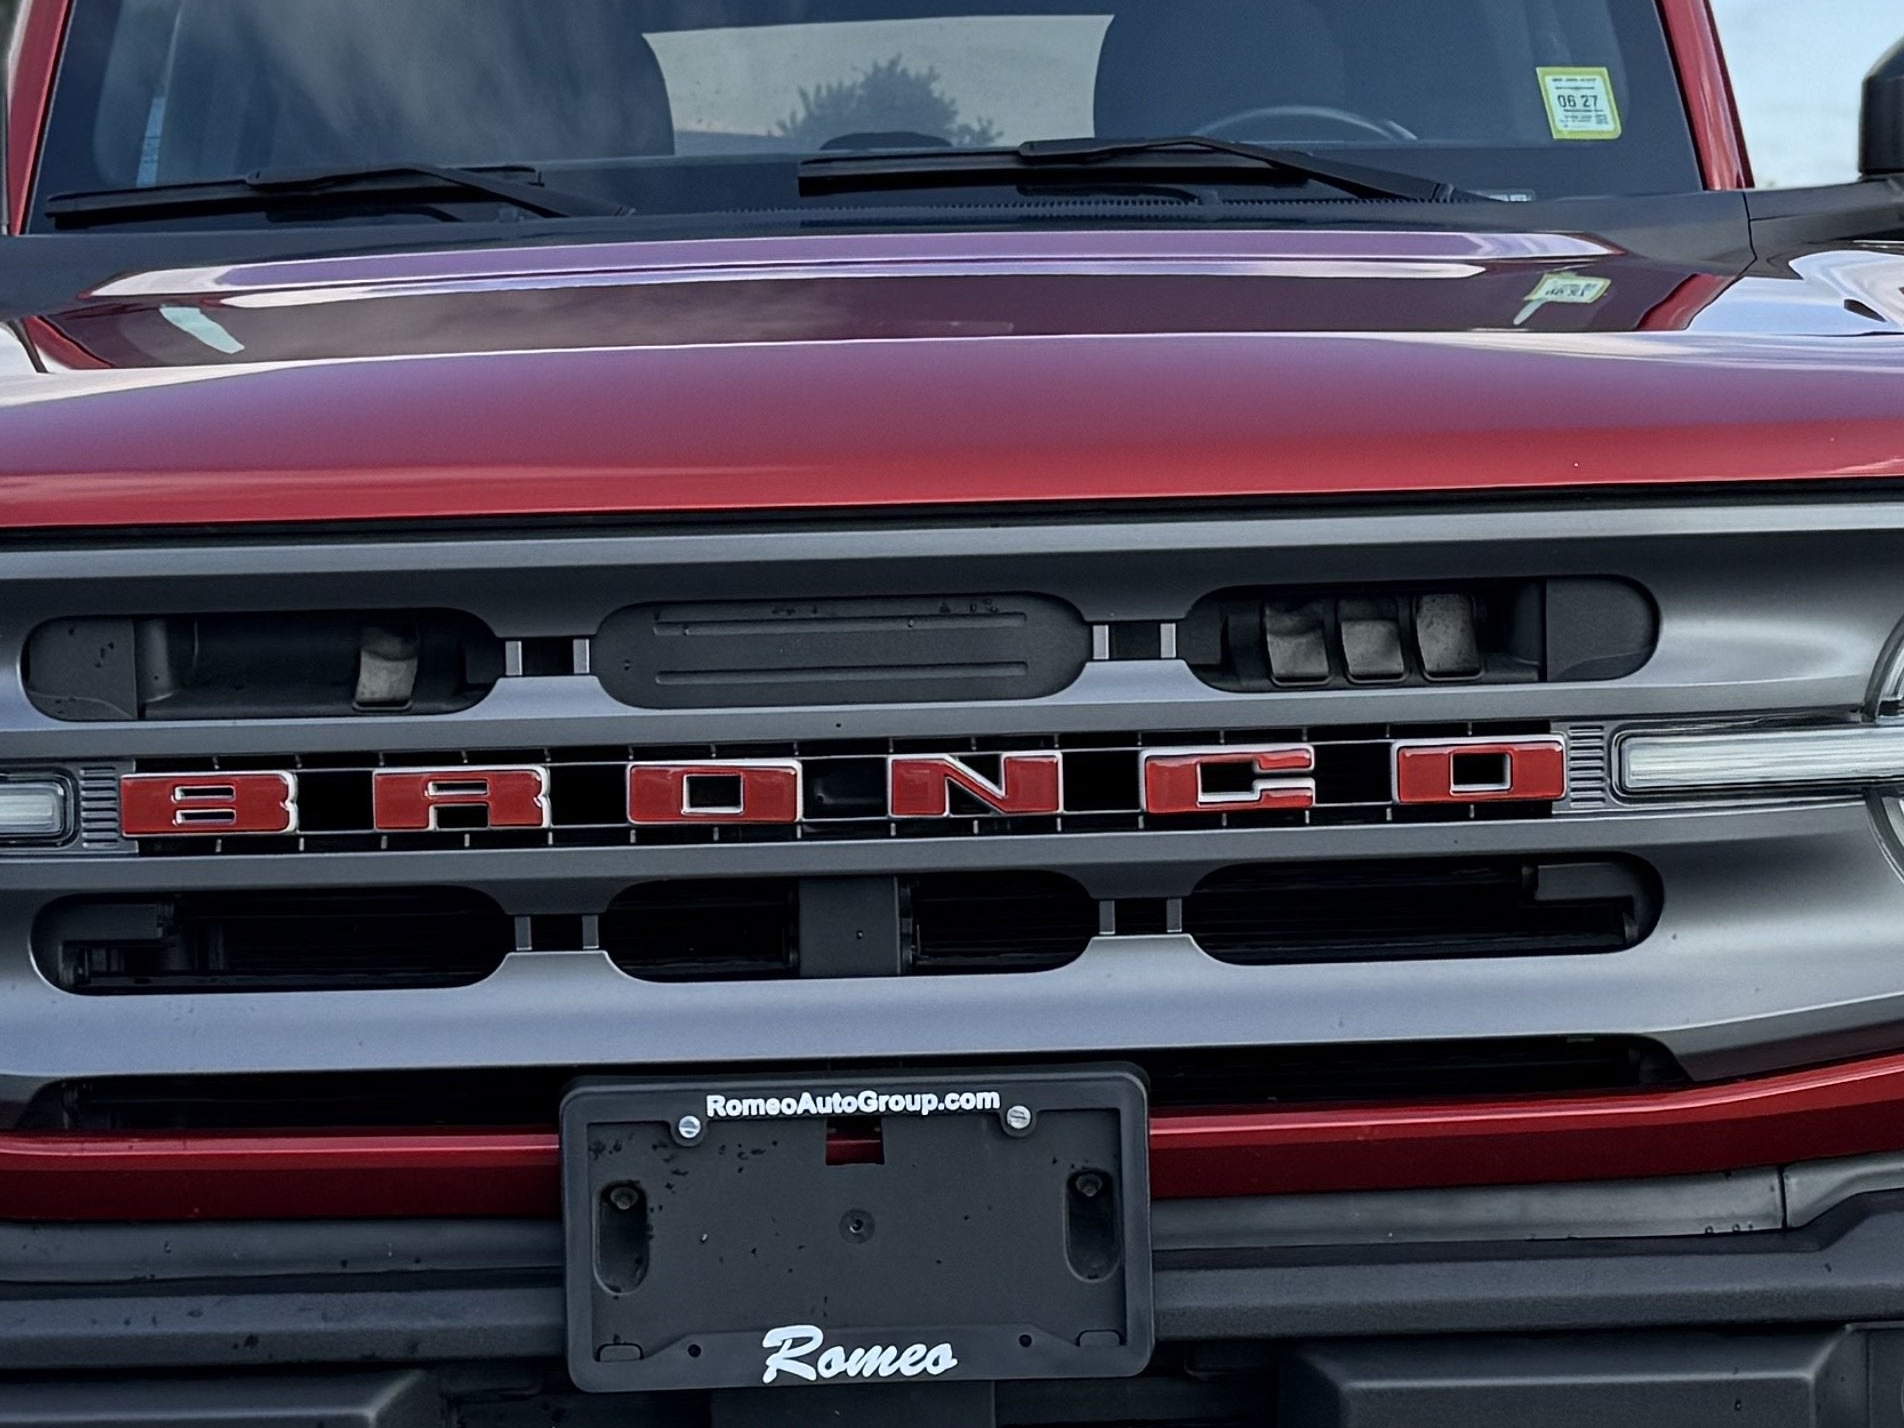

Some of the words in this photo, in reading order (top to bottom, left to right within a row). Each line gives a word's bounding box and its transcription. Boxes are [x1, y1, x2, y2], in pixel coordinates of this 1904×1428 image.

[1557, 94, 1577, 108] 06
[1581, 94, 1598, 109] 27
[119, 732, 1566, 838] BRONCO
[705, 1090, 1001, 1118] RomeoAutoGroup.com
[761, 1324, 958, 1384] Romeo
